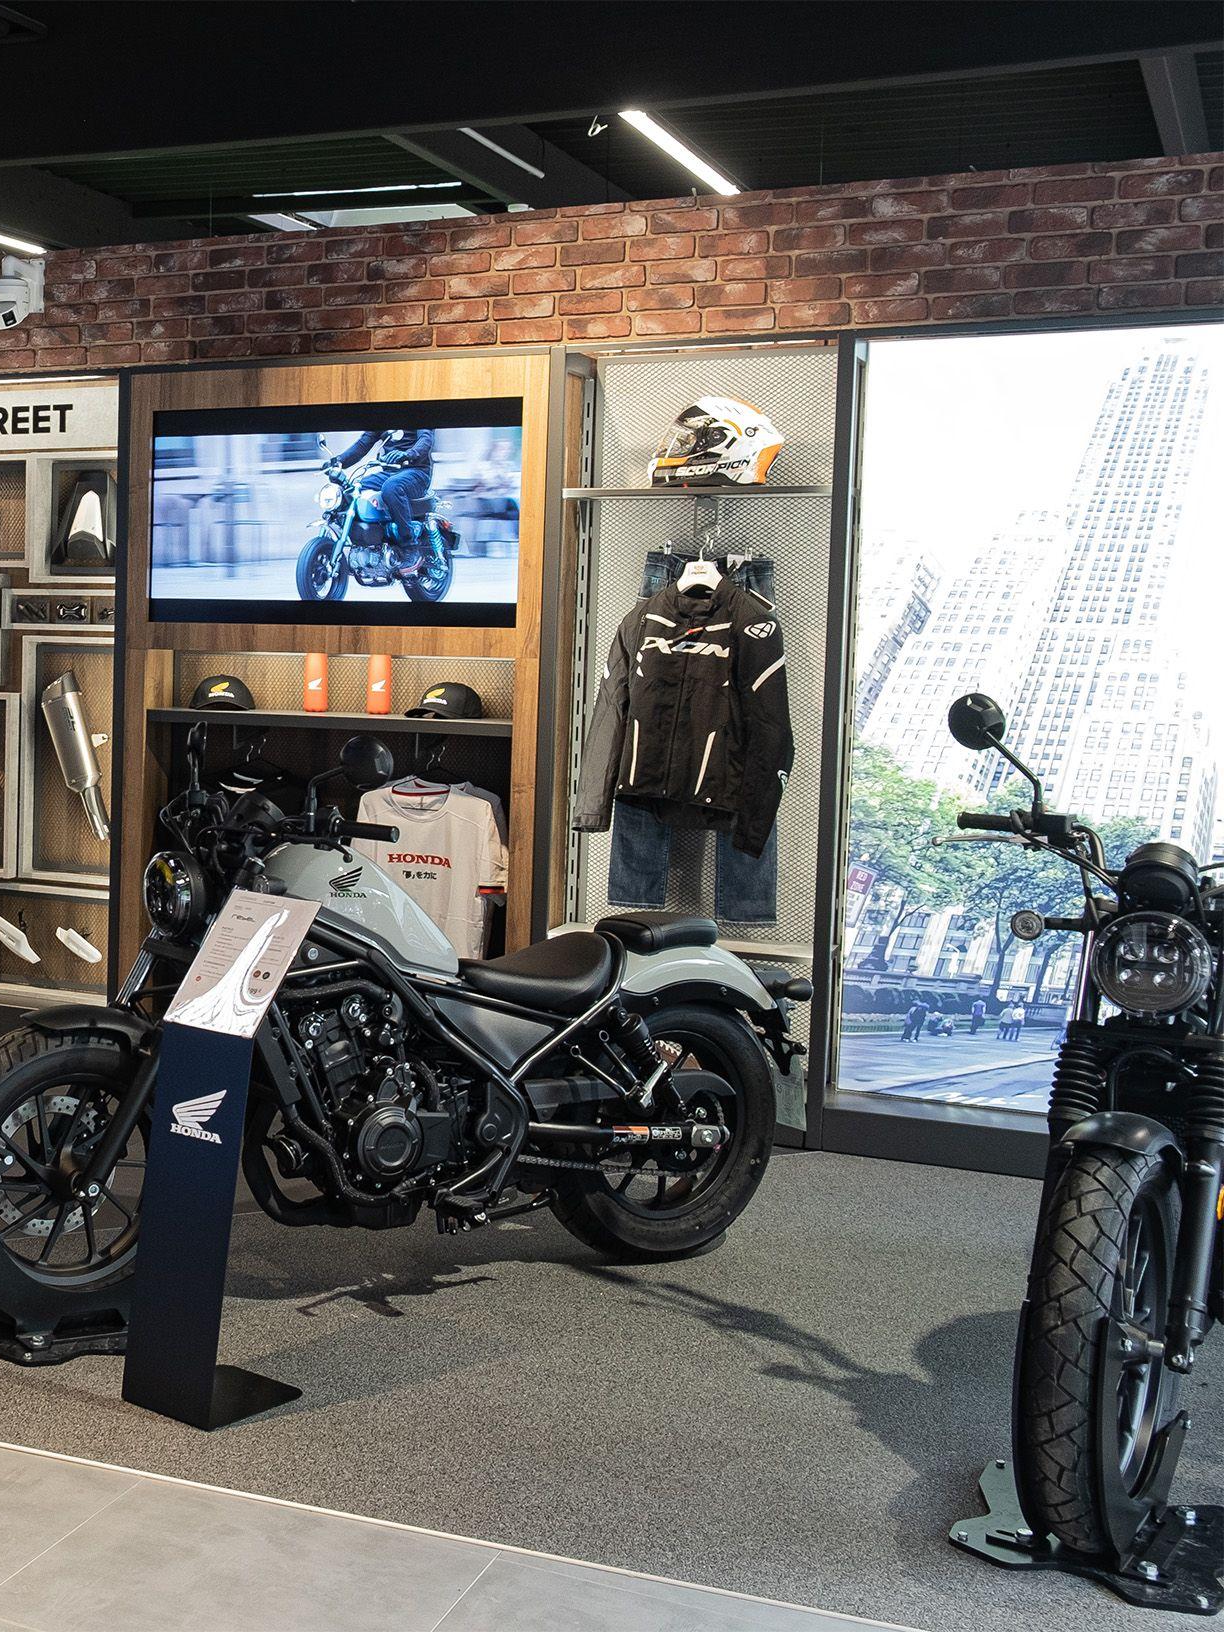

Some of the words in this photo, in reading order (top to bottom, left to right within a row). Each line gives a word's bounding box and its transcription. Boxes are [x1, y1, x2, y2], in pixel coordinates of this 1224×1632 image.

[675, 458, 751, 477] SCORPION
[387, 853, 452, 869] HONDA
[329, 891, 367, 899] HONDA
[169, 1122, 223, 1145] HONDA
